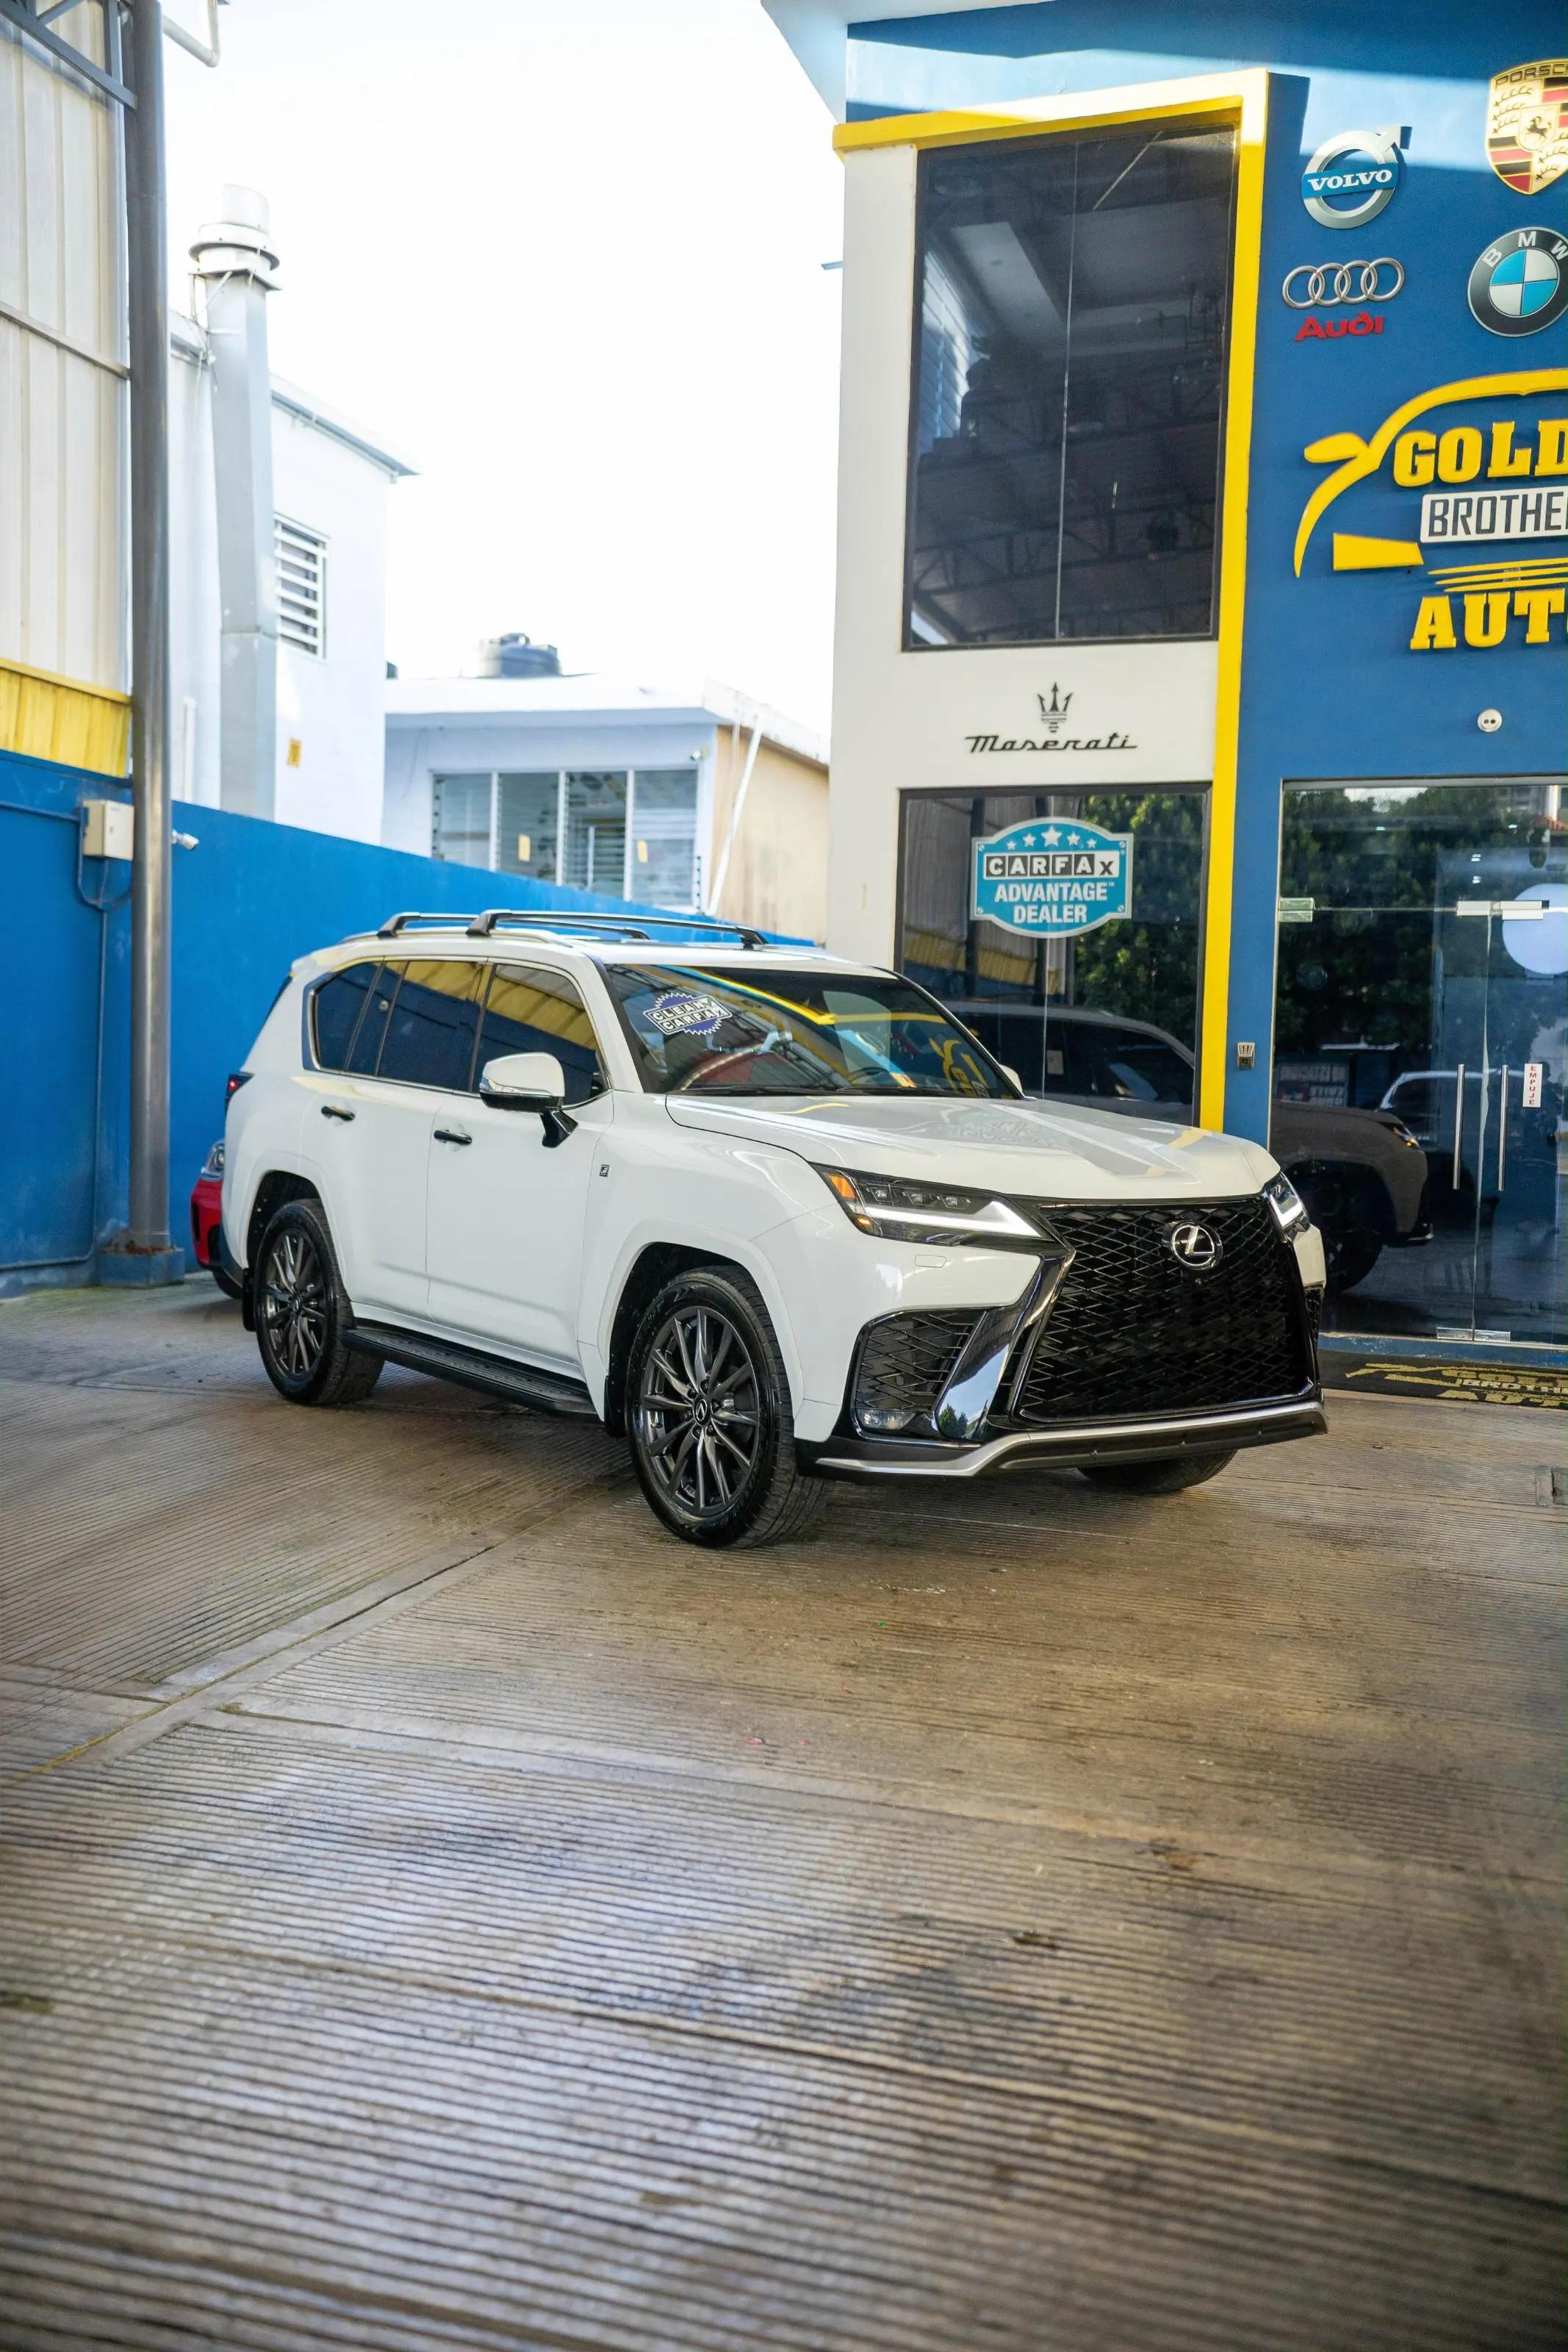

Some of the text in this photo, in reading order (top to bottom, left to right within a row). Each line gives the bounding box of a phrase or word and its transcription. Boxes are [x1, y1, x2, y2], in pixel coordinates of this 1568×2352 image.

[1495, 64, 1568, 90] PORSC
[1307, 169, 1392, 191] VOLVO
[1482, 231, 1568, 268] BMW
[1295, 311, 1384, 342] Audi
[1393, 420, 1568, 487] GOLD
[1428, 492, 1568, 537] BROTHE
[1410, 587, 1568, 650] AUT
[965, 733, 1137, 753] Maserati
[987, 855, 1115, 876] CARFAX
[1013, 904, 1087, 923] DEALER
[652, 1000, 706, 1021] CLEAN
[662, 1008, 725, 1030] CARFAX
[1529, 1066, 1537, 1105] EMPUJE
